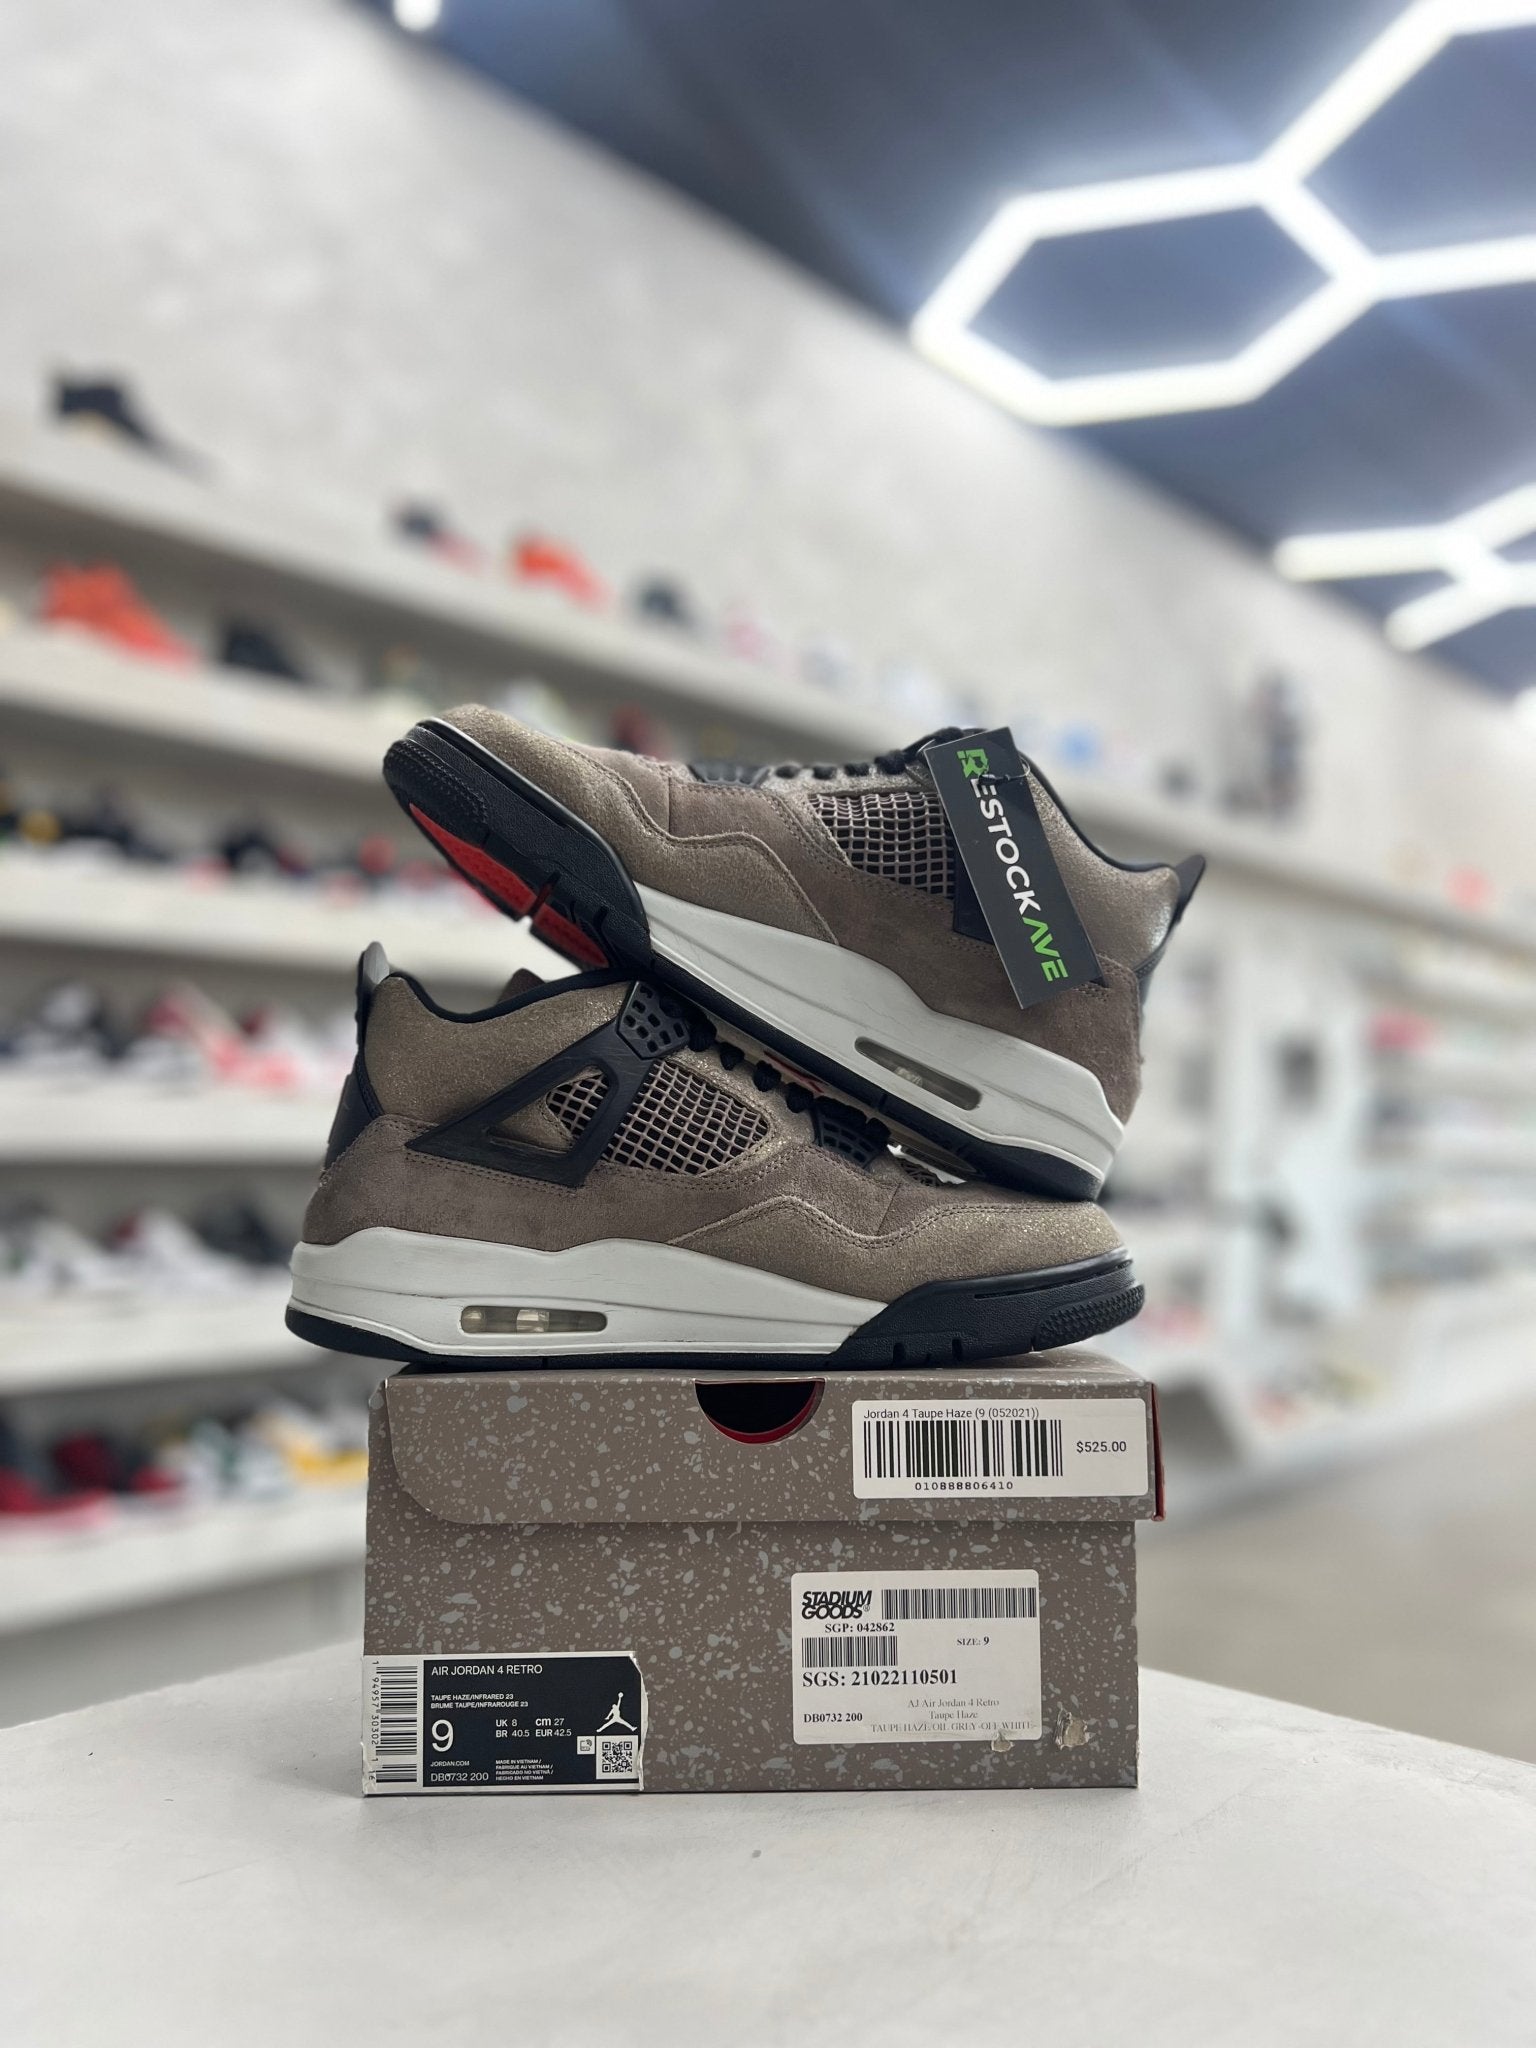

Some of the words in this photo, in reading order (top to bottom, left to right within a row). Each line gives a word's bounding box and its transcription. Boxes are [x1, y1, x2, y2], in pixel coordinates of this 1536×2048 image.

[864, 1409, 899, 1419] Jordan
[902, 1409, 909, 1418] 4
[912, 1409, 943, 1420] Taupe
[946, 1408, 972, 1418] Haze
[975, 1408, 985, 1419] (9
[988, 1408, 1039, 1419] (052021))
[1076, 1440, 1127, 1453] $525.00
[915, 1481, 1013, 1491] 010888806410
[802, 1590, 873, 1607] STADIUM
[802, 1605, 863, 1619] GOODS
[825, 1623, 853, 1633] SGP:
[857, 1622, 895, 1632] 042862
[957, 1638, 981, 1646] SIZE:
[983, 1637, 990, 1645] 9
[431, 1665, 449, 1676] AIR
[451, 1665, 495, 1675] JORDAN
[497, 1665, 504, 1674] 4
[506, 1664, 543, 1674] RETRO
[802, 1671, 845, 1687] SGS:
[851, 1669, 958, 1686] 21022110501
[923, 1699, 935, 1707] Air
[938, 1699, 966, 1707] Jordan
[976, 1698, 1000, 1707] Retro
[803, 1713, 842, 1724] DB0732
[846, 1713, 863, 1723] 200
[930, 1711, 953, 1721] Taupe
[956, 1710, 978, 1718] Haze
[496, 1719, 508, 1727] UK
[512, 1719, 518, 1727] 8
[535, 1718, 551, 1726] cm
[554, 1718, 565, 1726] 27
[431, 1719, 454, 1752] 9
[496, 1730, 508, 1738] BR
[512, 1729, 530, 1738] 40.5
[535, 1729, 553, 1737] EUR
[554, 1729, 572, 1737] 42.5
[470, 1772, 489, 1781] 200
